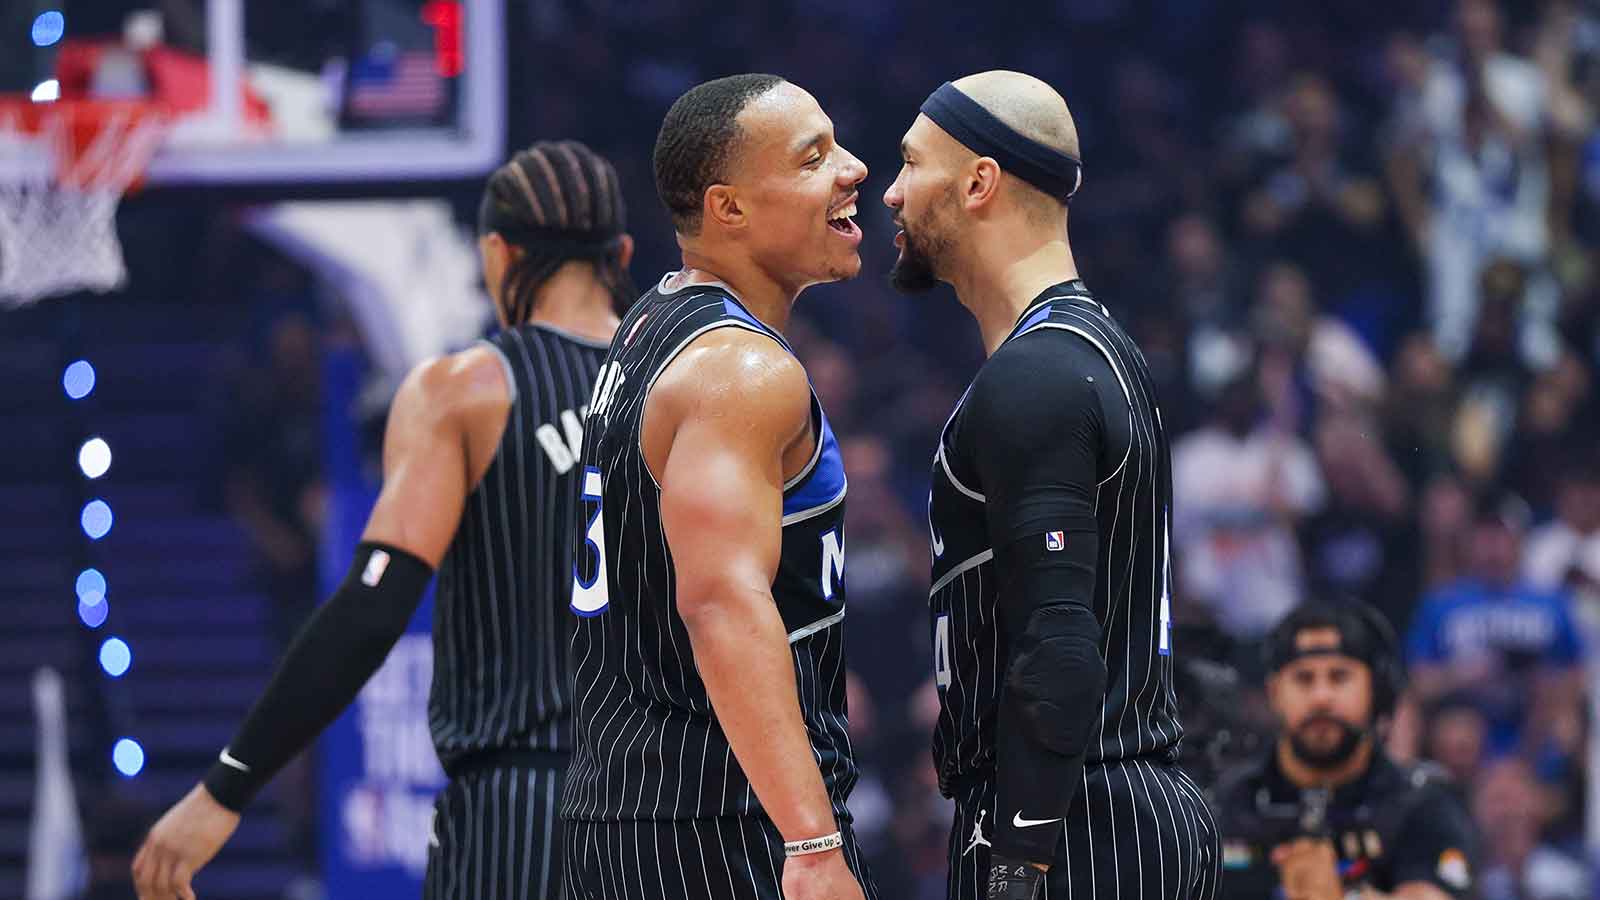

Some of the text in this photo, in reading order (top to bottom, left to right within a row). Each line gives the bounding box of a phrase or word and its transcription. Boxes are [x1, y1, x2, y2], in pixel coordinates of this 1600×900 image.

[569, 465, 609, 617] 3
[801, 841, 823, 851] Give
[824, 837, 835, 848] Up
